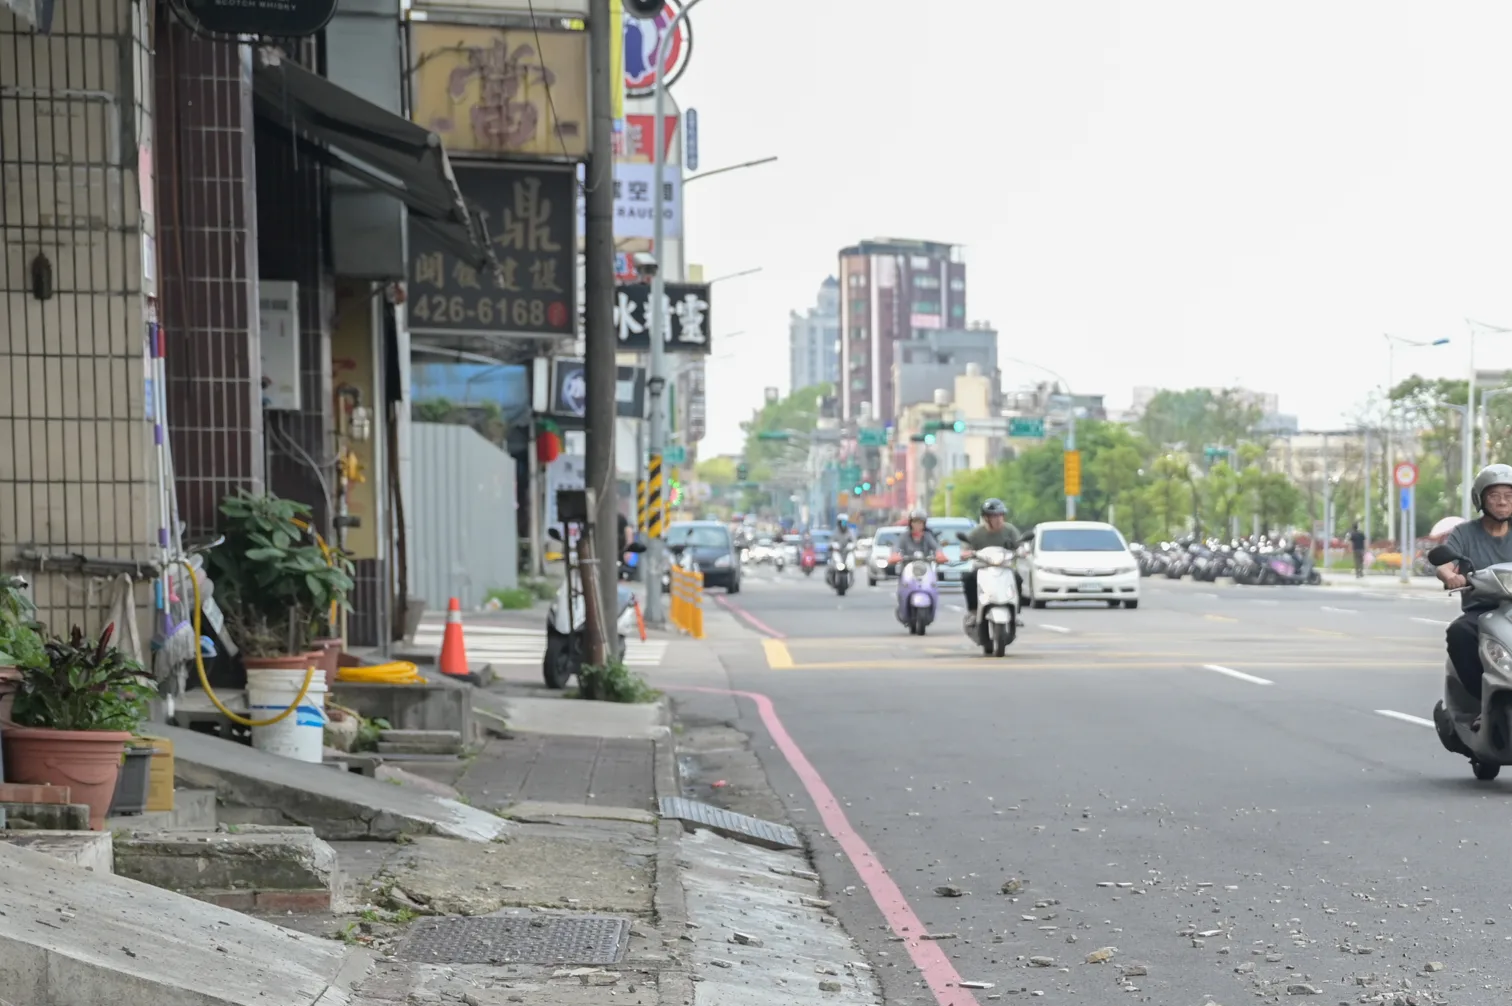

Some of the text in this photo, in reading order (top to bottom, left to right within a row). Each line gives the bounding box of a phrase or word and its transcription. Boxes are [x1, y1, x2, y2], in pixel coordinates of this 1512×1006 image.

[259, 2, 297, 11] WHISKY
[493, 176, 562, 252] 鼎
[413, 294, 545, 325] 426-6168
